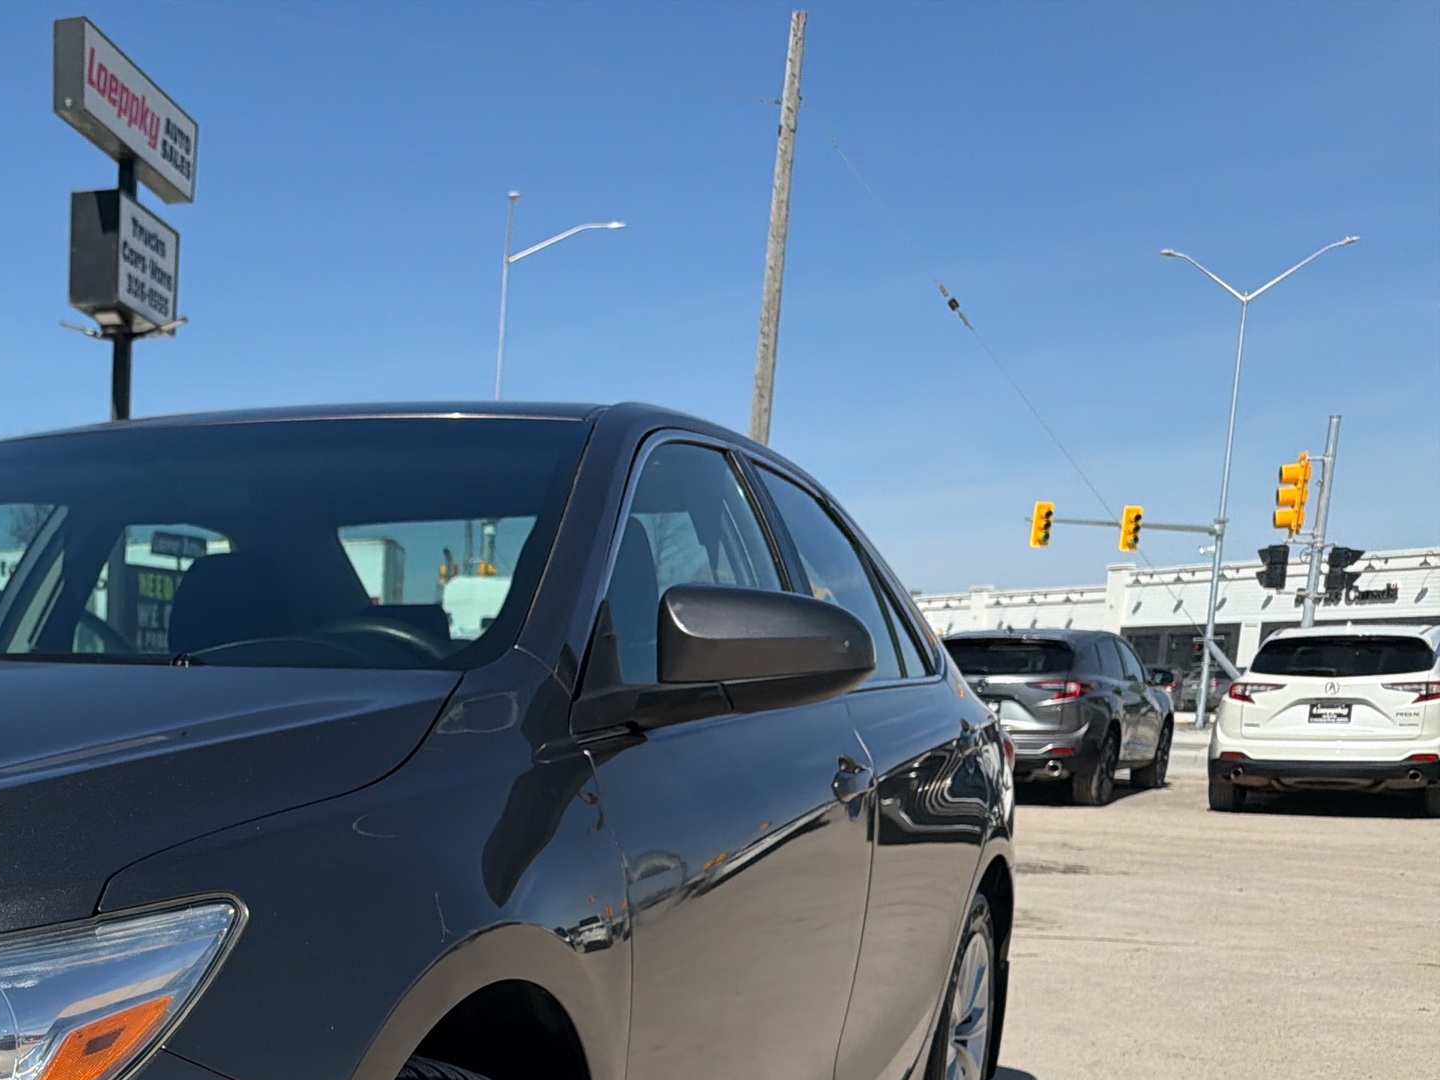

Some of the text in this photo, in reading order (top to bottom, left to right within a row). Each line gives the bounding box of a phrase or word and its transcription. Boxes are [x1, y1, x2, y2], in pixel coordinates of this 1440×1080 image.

[87, 46, 160, 150] Loeppky
[164, 116, 192, 156] AUTO
[160, 138, 192, 181] SALES
